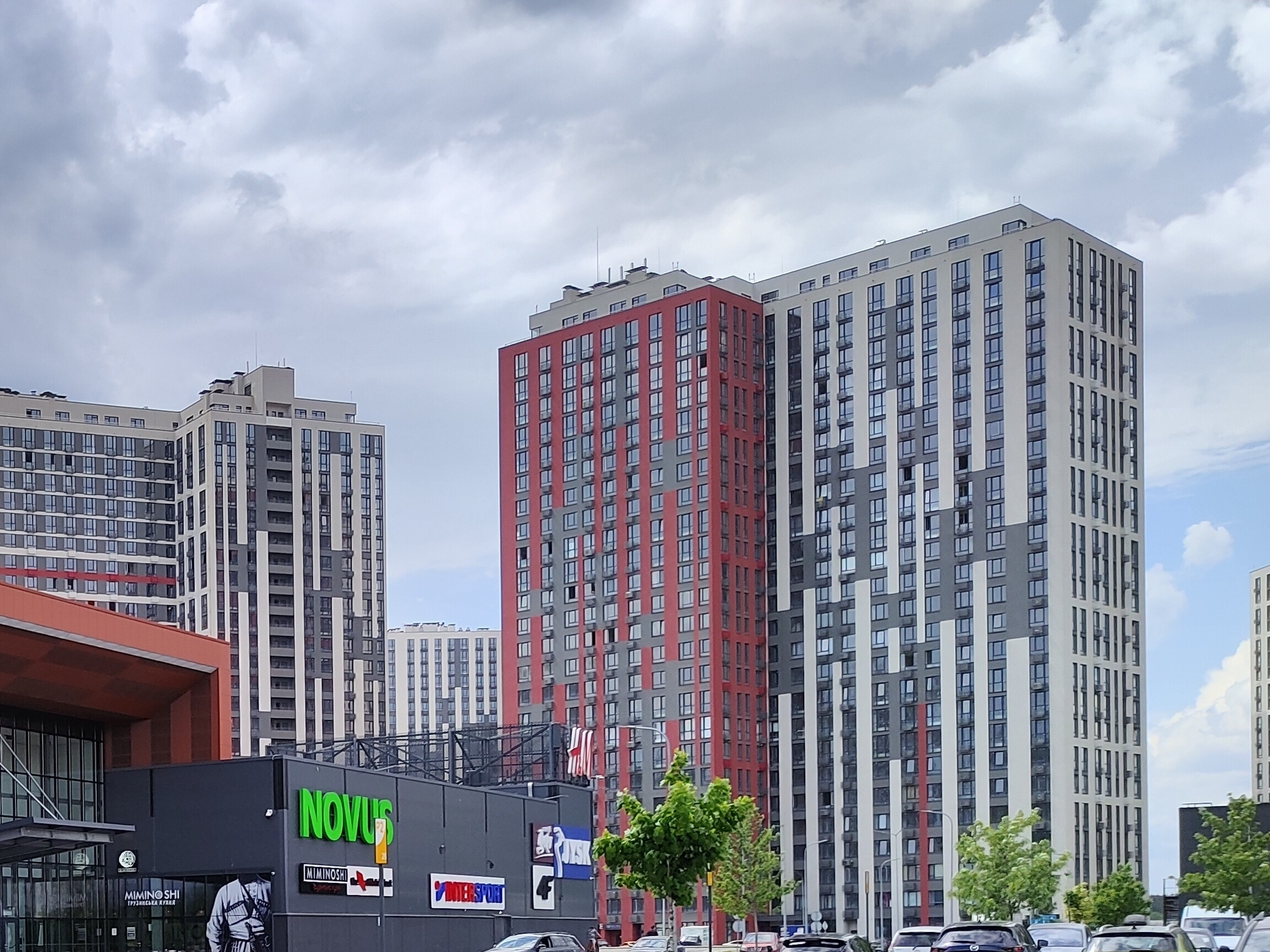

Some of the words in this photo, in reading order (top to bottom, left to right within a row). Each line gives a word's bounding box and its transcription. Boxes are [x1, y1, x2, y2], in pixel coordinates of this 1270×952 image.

[298, 788, 394, 846] NOVUS
[562, 839, 591, 866] JYSK
[306, 867, 347, 880] MIMINOSHI
[445, 881, 505, 904] INTERSPORT
